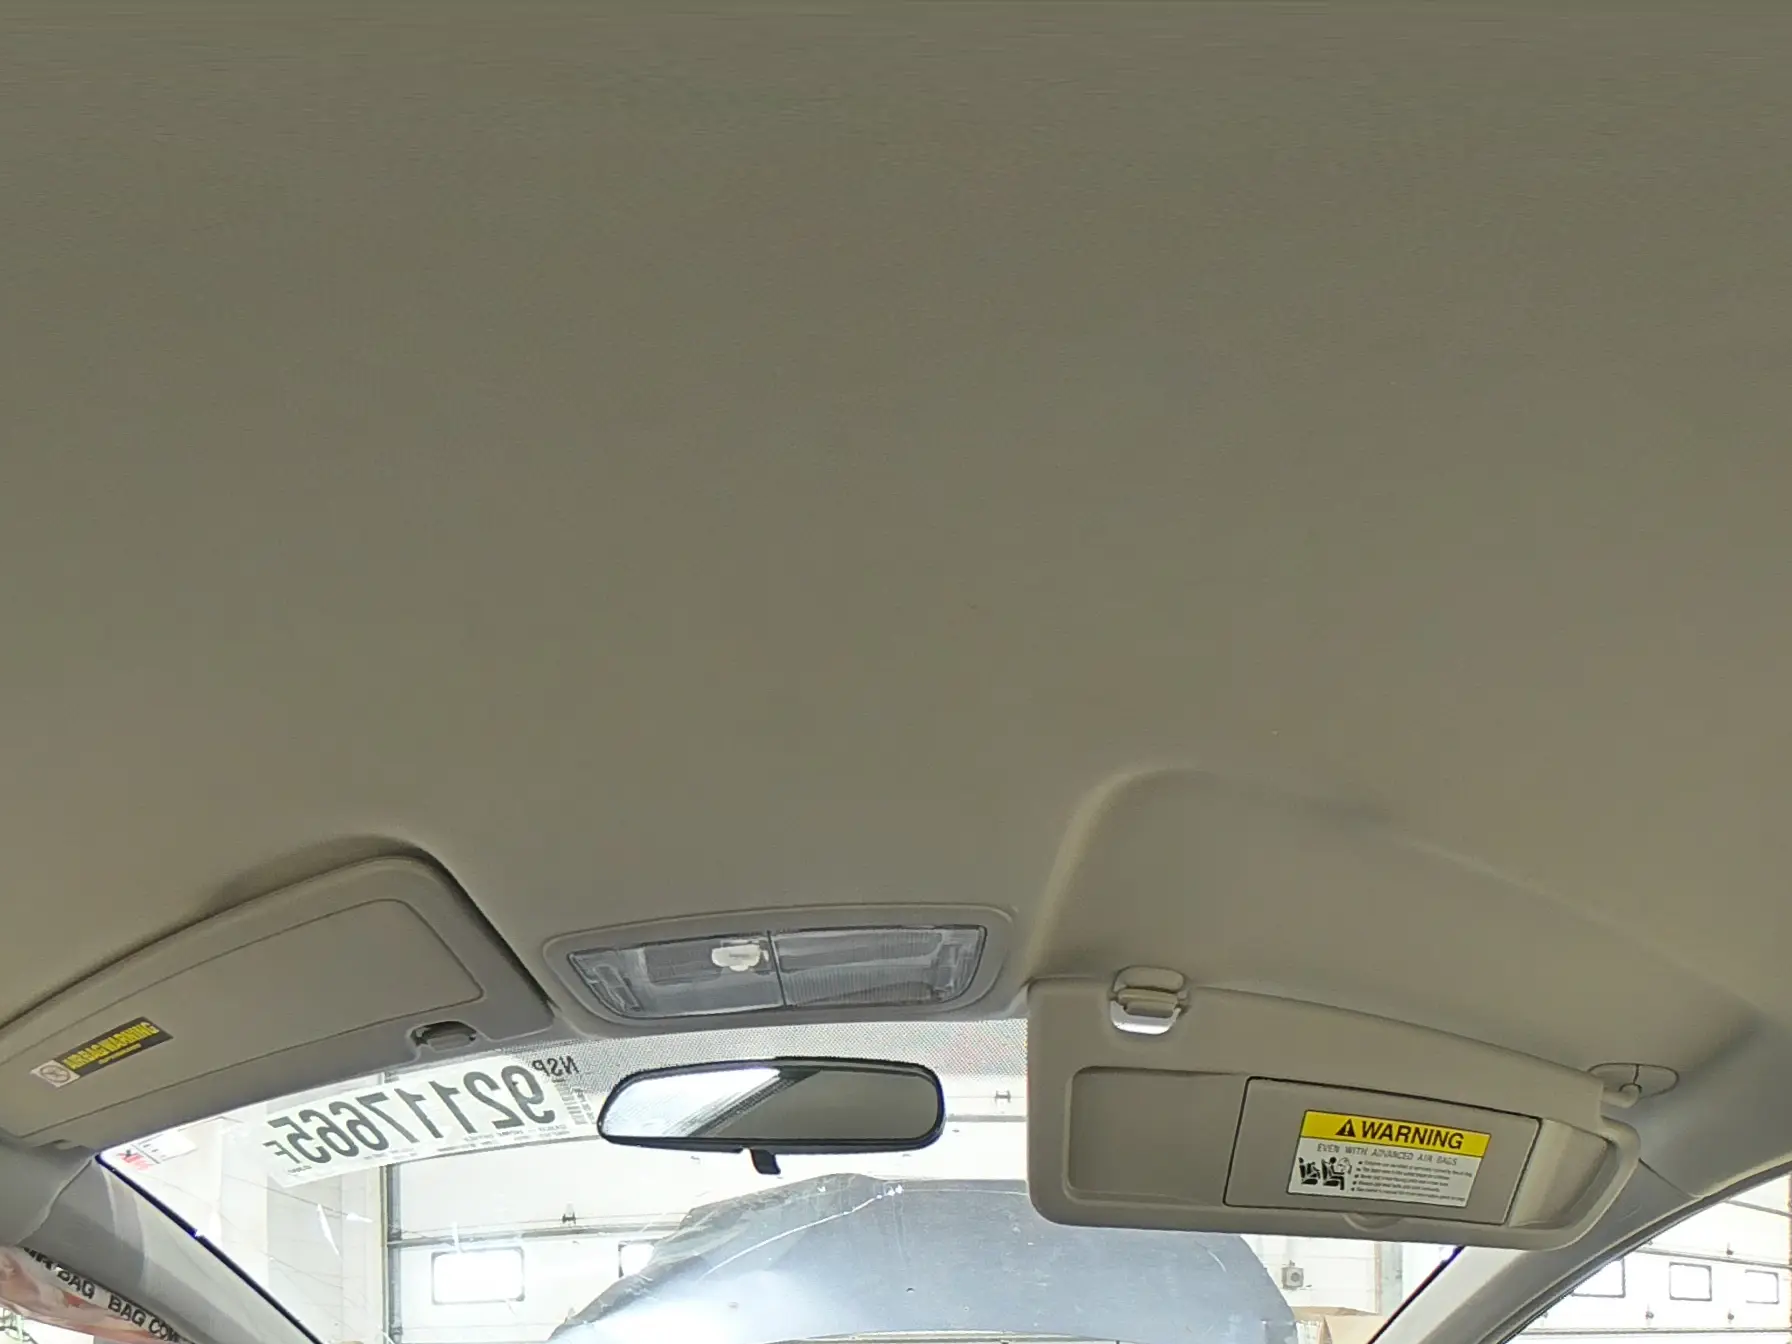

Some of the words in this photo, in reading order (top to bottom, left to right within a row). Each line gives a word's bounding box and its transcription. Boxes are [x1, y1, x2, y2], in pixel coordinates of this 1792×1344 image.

[1361, 1121, 1465, 1150] WARNING
[1317, 1143, 1340, 1154] EVEN
[1345, 1145, 1368, 1156] WITH
[1371, 1148, 1414, 1161] ADVANCED
[108, 1293, 146, 1326] BAG
